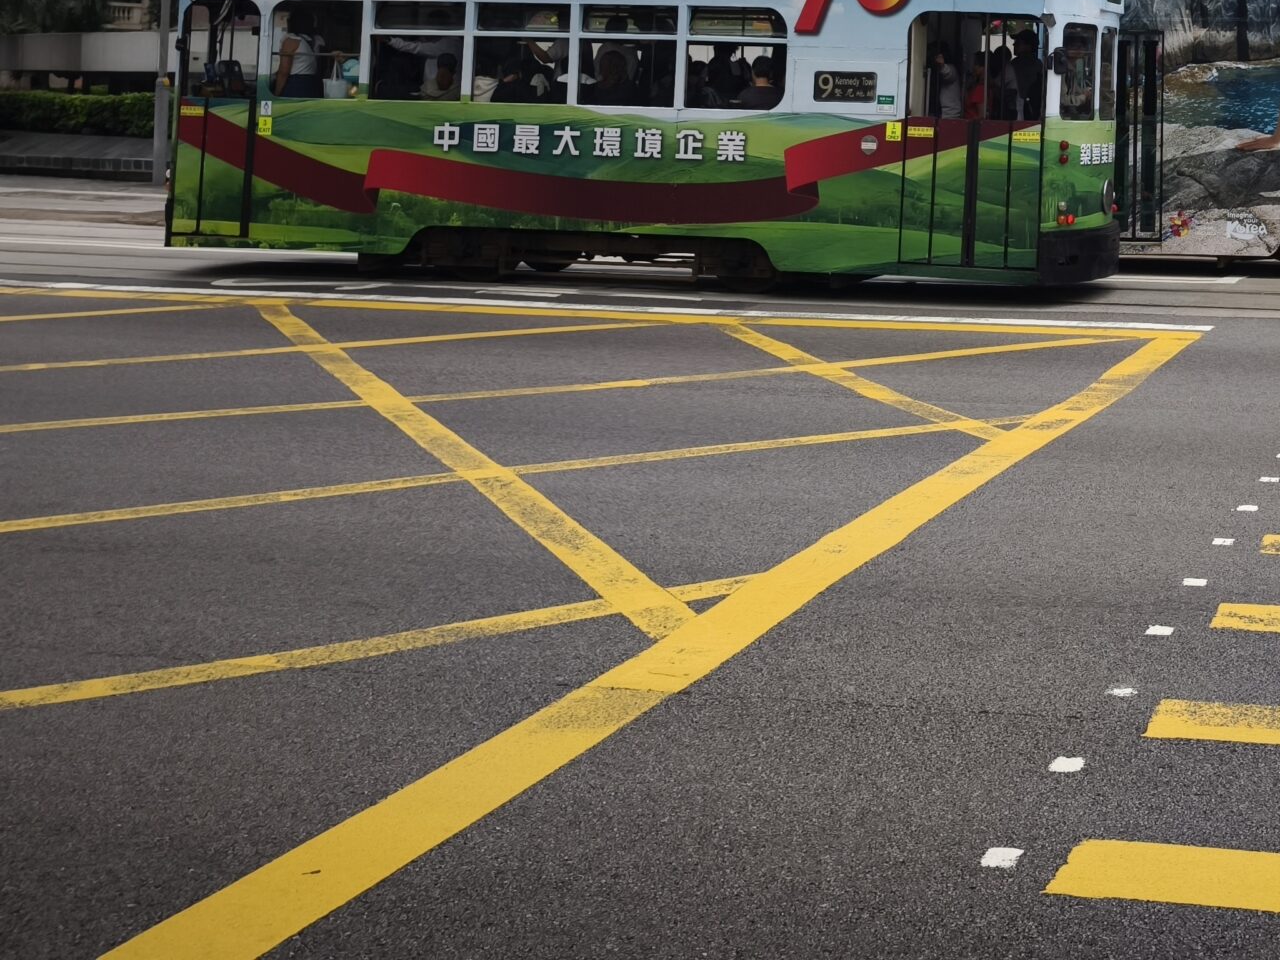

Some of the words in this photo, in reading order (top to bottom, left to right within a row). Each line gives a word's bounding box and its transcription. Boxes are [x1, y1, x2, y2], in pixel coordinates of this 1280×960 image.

[818, 73, 834, 98] 9
[835, 76, 860, 87] Kennedy
[433, 122, 746, 162] 中國最大環境企業
[1227, 211, 1253, 219] Imagine
[1226, 220, 1268, 240] Korea
